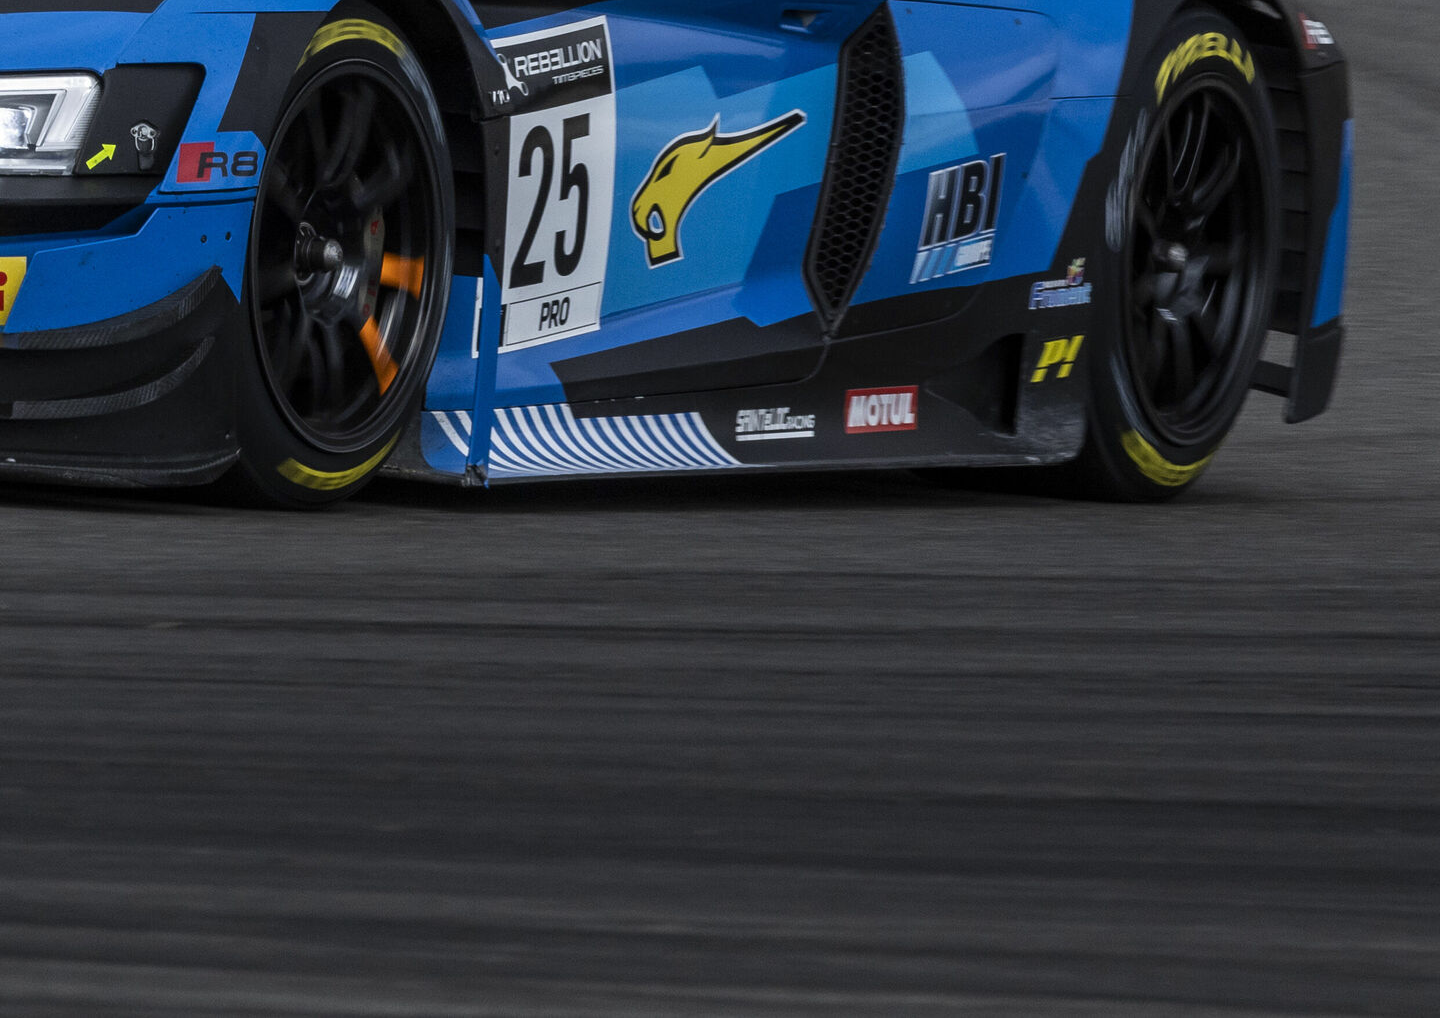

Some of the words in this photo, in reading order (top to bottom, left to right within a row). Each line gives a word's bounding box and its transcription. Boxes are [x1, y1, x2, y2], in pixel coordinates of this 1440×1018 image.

[515, 41, 604, 78] REBELLION
[196, 150, 258, 179] R8
[508, 112, 590, 289] 25
[919, 152, 1006, 250] HBI
[538, 297, 570, 331] PRO
[847, 393, 915, 428] MOTUL
